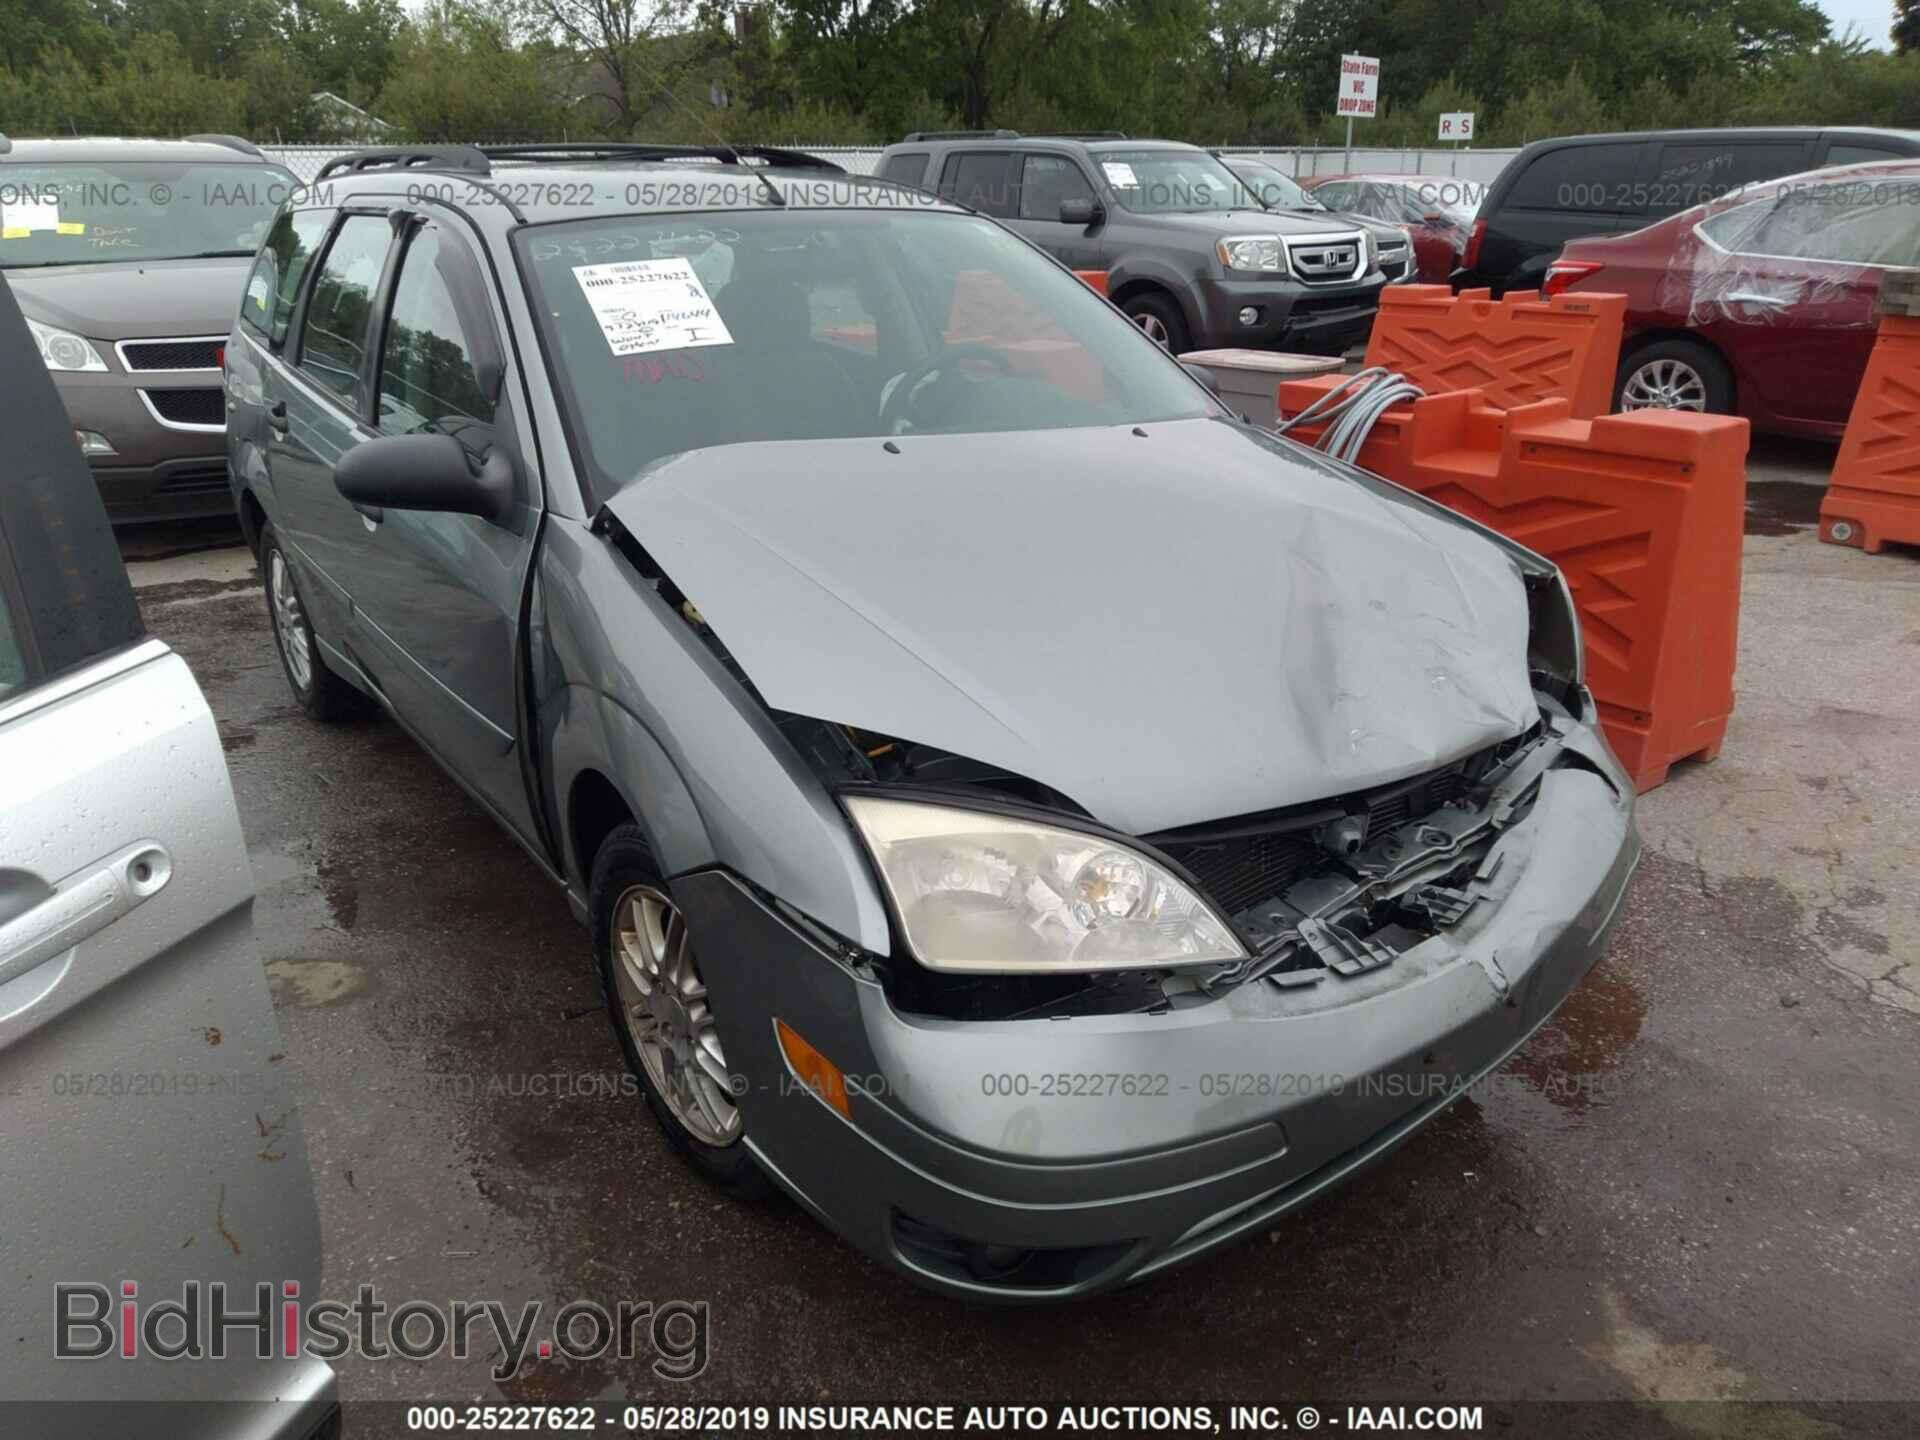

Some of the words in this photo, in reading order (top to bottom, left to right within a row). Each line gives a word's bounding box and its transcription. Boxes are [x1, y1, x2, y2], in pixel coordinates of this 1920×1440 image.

[1343, 60, 1360, 74] State
[1360, 62, 1378, 76] Farm
[1340, 98, 1358, 112] DROP
[1358, 99, 1375, 113] ZONE
[1442, 119, 1452, 134] R
[1461, 119, 1470, 134] S
